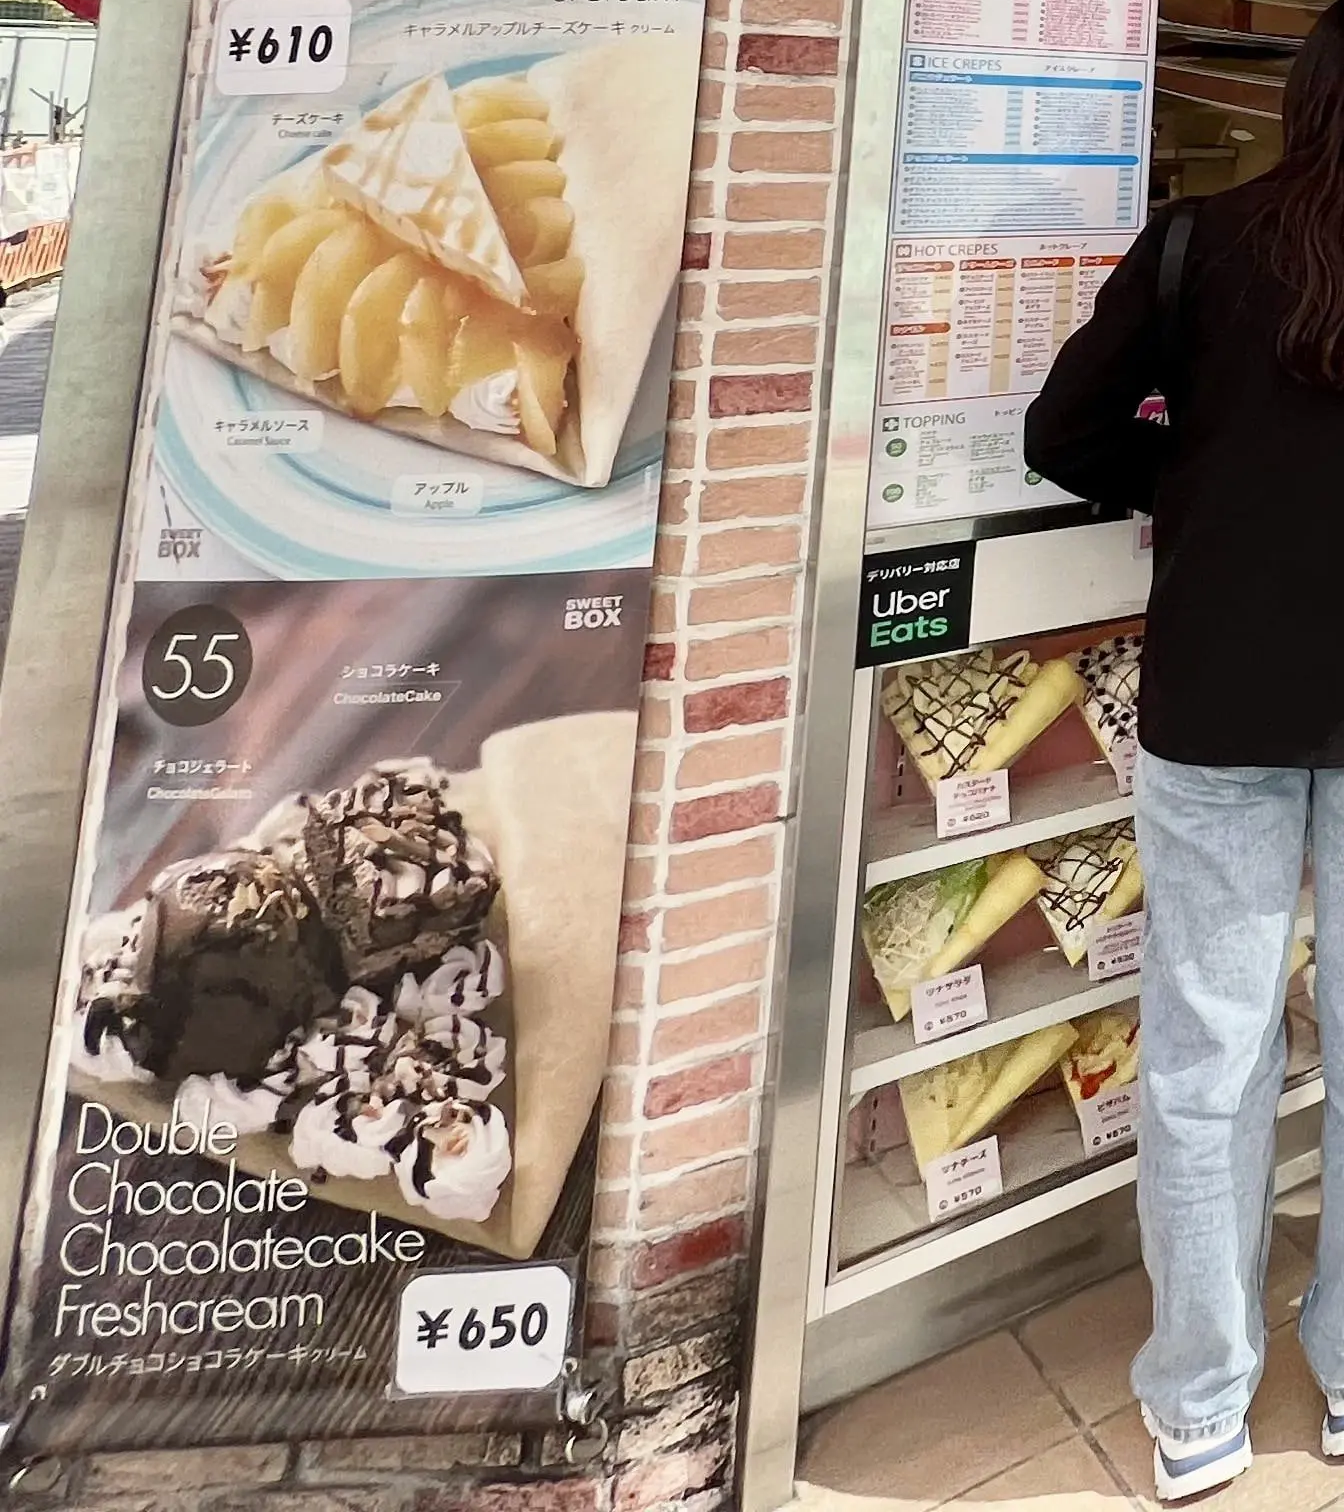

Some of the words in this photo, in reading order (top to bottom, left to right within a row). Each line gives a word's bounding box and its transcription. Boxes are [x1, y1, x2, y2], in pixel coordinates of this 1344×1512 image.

[228, 24, 333, 65] ¥610
[928, 56, 949, 69] ICE
[953, 57, 1003, 72] CREPES
[914, 244, 944, 258] HOT
[947, 243, 999, 257] CREPES
[215, 420, 309, 433] キャラメルソース
[903, 411, 966, 430] TOPPING
[414, 481, 469, 496] アップル
[866, 558, 961, 582] デリバリー対応店
[565, 595, 624, 612] SWEET
[872, 586, 950, 619] Uber
[563, 608, 624, 630] BOX
[870, 613, 948, 649] Eats
[152, 634, 240, 701] 55
[340, 662, 442, 680] ショコラケーキ
[152, 759, 254, 776] チョコジェラート
[75, 1102, 239, 1157] Double
[67, 1161, 309, 1218] Chocolate
[60, 1211, 426, 1279] Chocolatecake
[53, 1284, 325, 1338] Freshcream
[415, 1301, 549, 1351] ¥650
